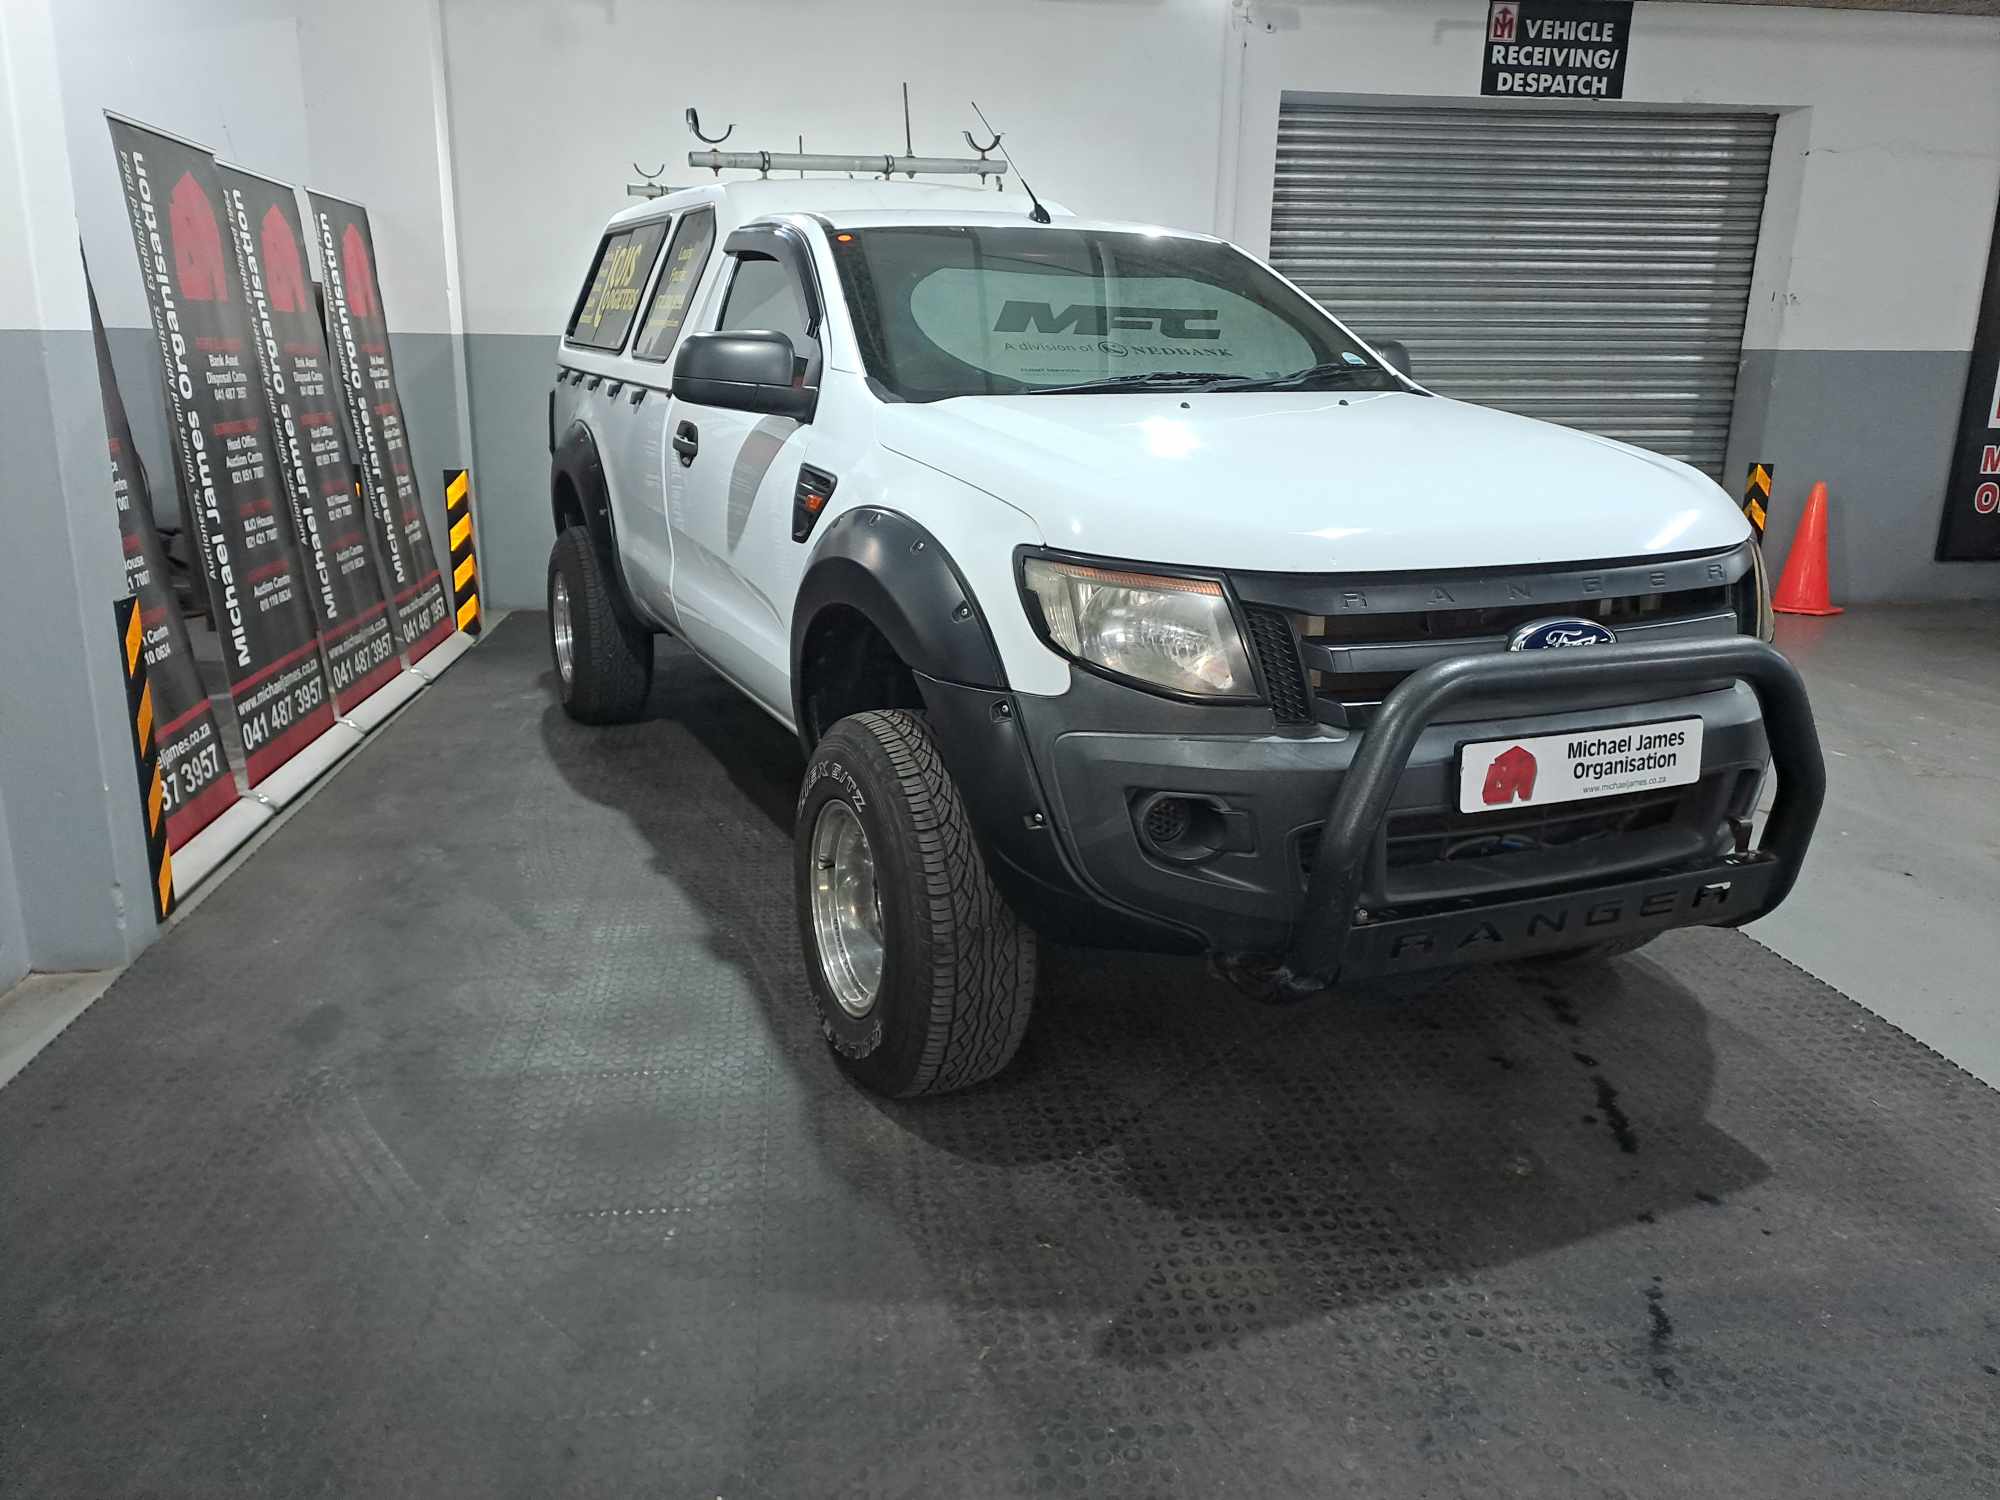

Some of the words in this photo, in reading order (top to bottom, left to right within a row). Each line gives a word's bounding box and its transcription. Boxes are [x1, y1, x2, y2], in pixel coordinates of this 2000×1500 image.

[1491, 45, 1619, 70] RECEIVING/
[1526, 19, 1615, 43] VEHICLE
[1496, 72, 1608, 95] DESPATCH
[120, 150, 135, 193] 1964
[128, 196, 156, 290] Established
[133, 151, 192, 400] Organisation
[232, 189, 285, 395] Organisation
[320, 212, 362, 389] Organisation
[153, 305, 177, 389] Appraisers
[992, 300, 1221, 340] MFC
[1019, 341, 1076, 353] division
[1130, 344, 1233, 357] NEDBANK
[170, 391, 184, 422] and
[179, 426, 196, 483] Valuers
[280, 403, 310, 499] James
[357, 397, 381, 479] James
[187, 411, 220, 525] James
[1974, 482, 2000, 514] O
[193, 488, 217, 580] Auctioneers,
[301, 506, 338, 619] Michael
[375, 486, 405, 583] Michael
[211, 533, 251, 668] Michael
[402, 619, 420, 643] 041
[237, 658, 318, 716] www.michaeljames.co.za
[332, 658, 354, 689] 041
[354, 645, 373, 675] 487
[371, 632, 393, 663] 3957
[242, 711, 269, 750] 041
[271, 695, 293, 730] 487
[295, 675, 322, 714] 3957
[181, 743, 219, 793] 3957
[1568, 735, 1632, 759] Michael
[1635, 731, 1685, 751] James
[1573, 752, 1677, 780] Organisation
[1583, 776, 1667, 793] www.michaeljames.co.za
[1389, 881, 1732, 959] RANGER
